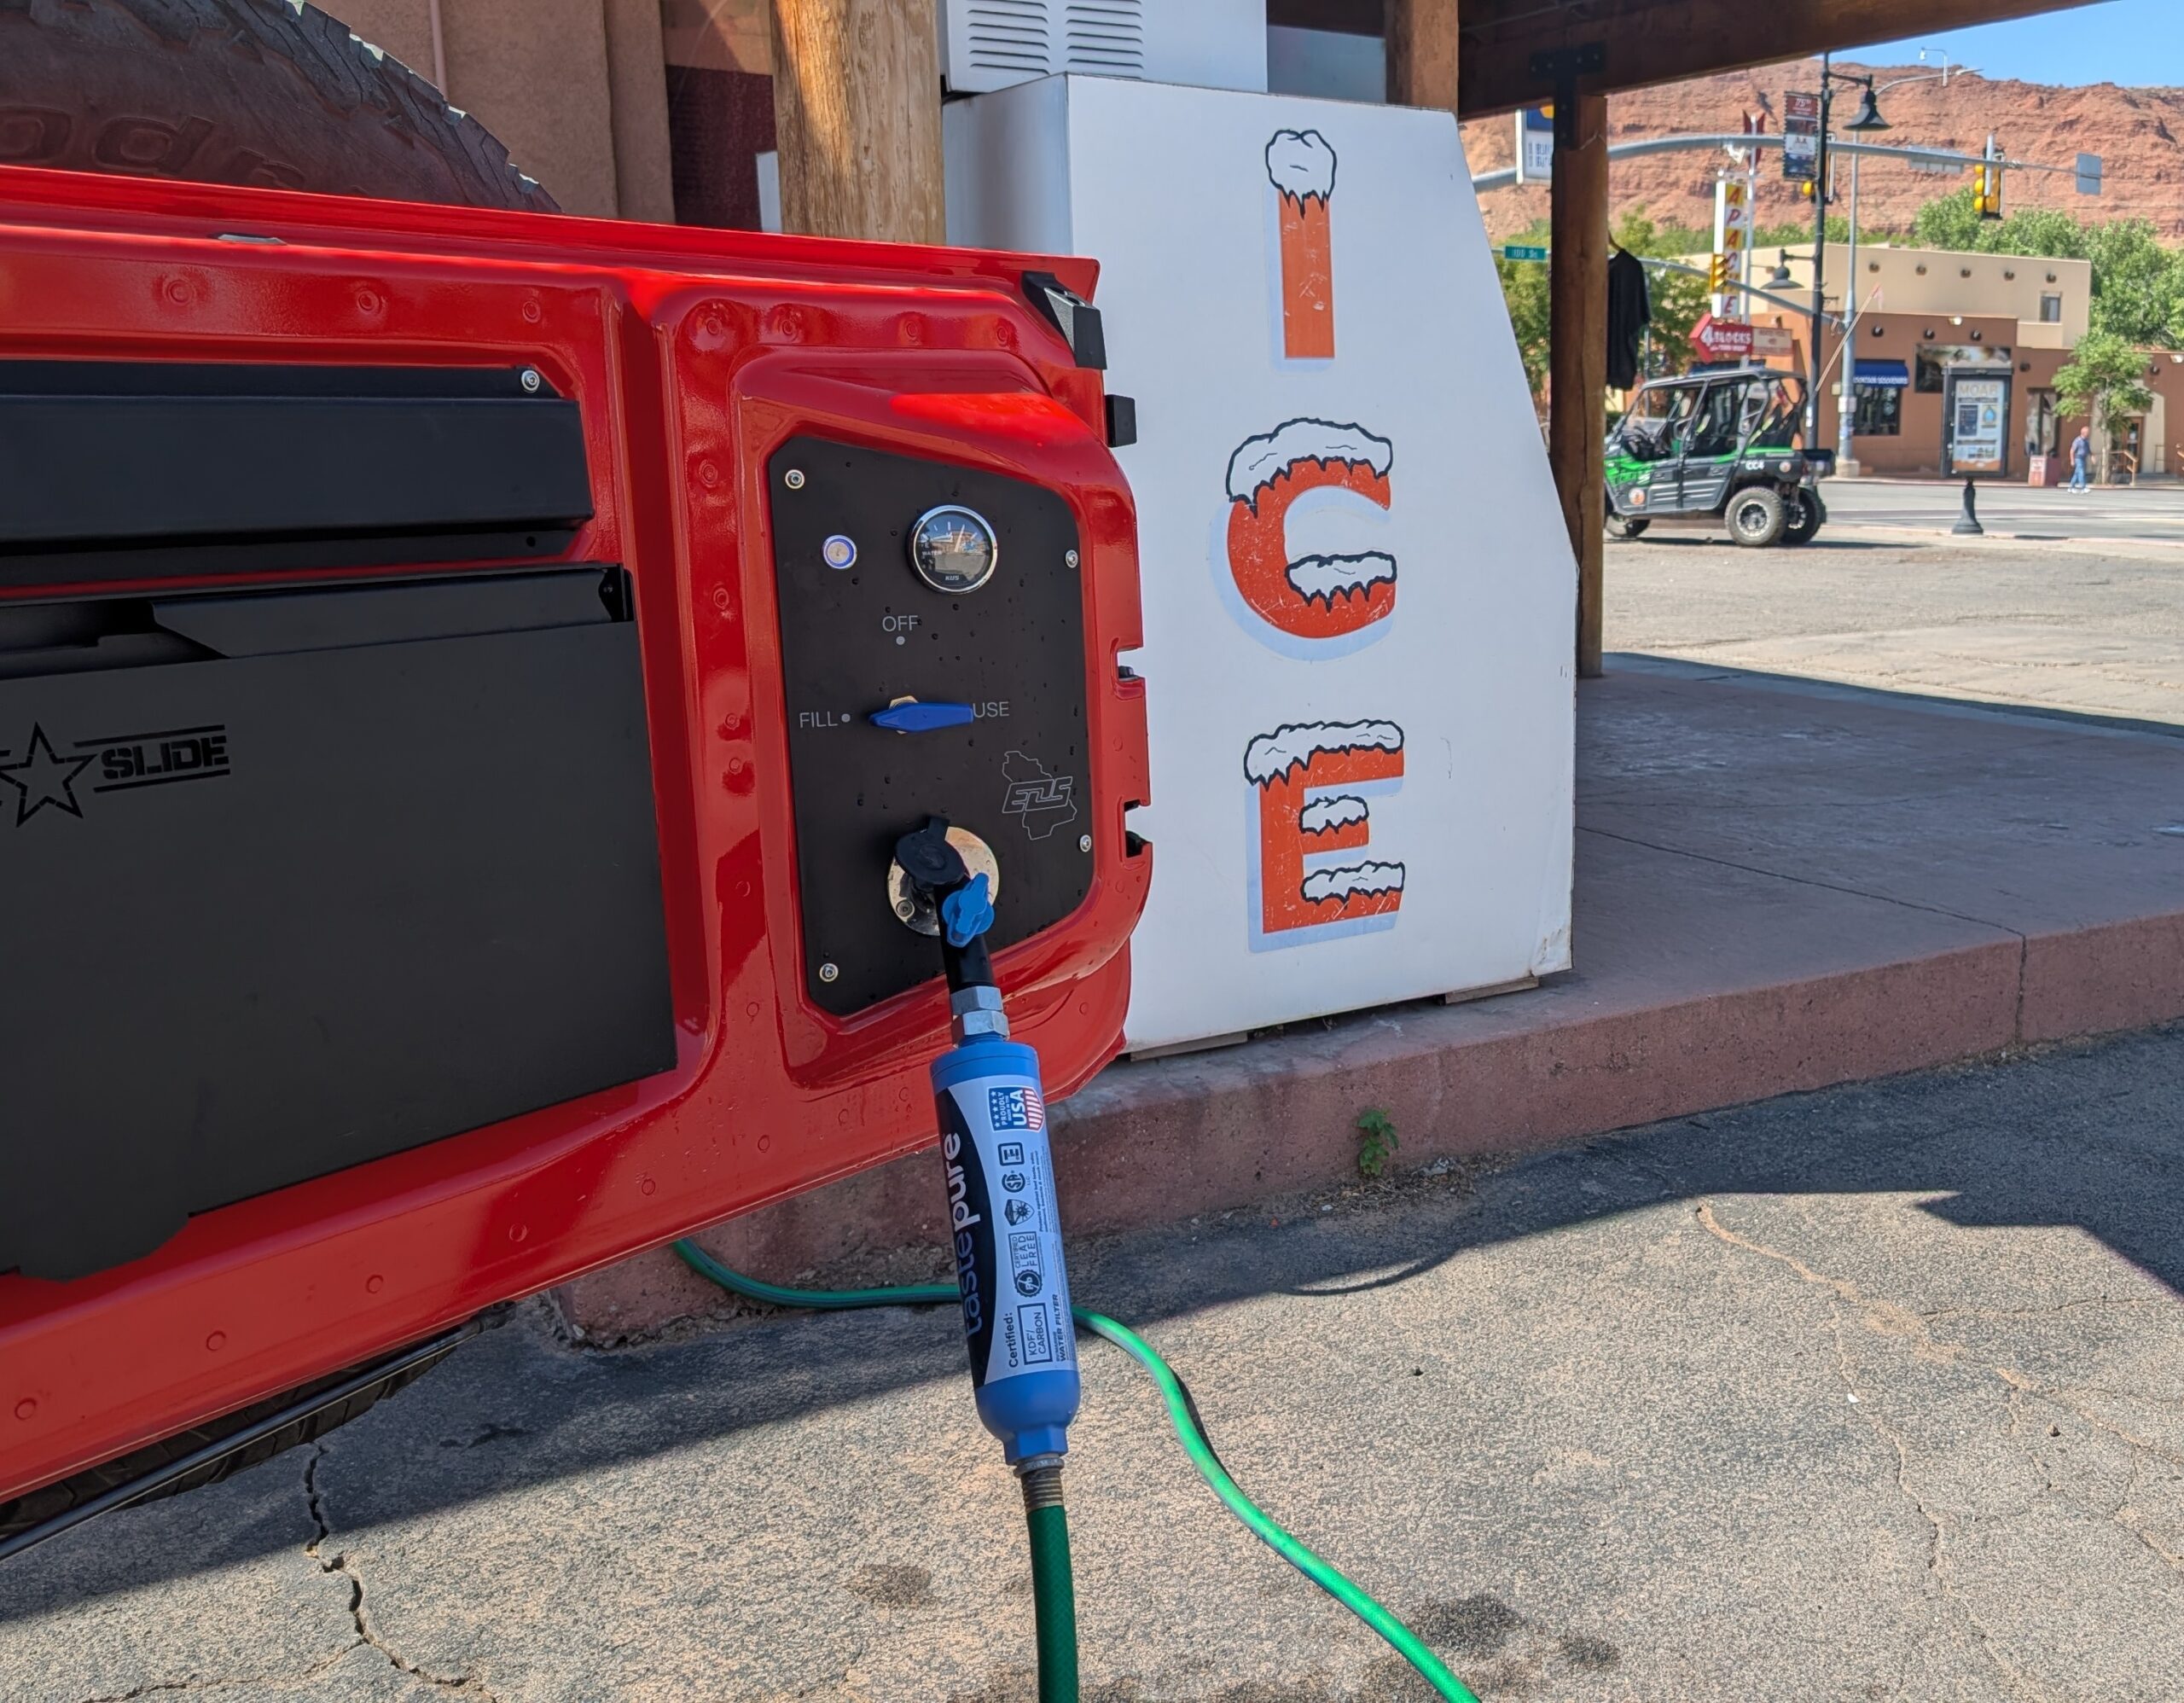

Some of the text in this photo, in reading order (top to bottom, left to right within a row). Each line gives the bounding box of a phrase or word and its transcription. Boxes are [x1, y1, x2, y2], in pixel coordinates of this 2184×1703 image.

[1700, 325, 1713, 346] 4
[1226, 129, 1405, 935] ICE
[882, 615, 918, 632] OFF
[799, 712, 838, 728] FILL
[973, 701, 1010, 718] USE
[102, 735, 229, 779] SLIDE
[997, 1091, 1008, 1125] PROUDLY
[1009, 1090, 1027, 1126] USA
[1012, 1236, 1020, 1268] CERTIFIED
[1018, 1235, 1029, 1267] LEAD
[1026, 1235, 1037, 1267] FREE
[1052, 1294, 1061, 1326] FILTER
[1003, 1312, 1018, 1367] Certified:
[1034, 1312, 1046, 1353] CARBON
[1056, 1328, 1066, 1361] WATER
